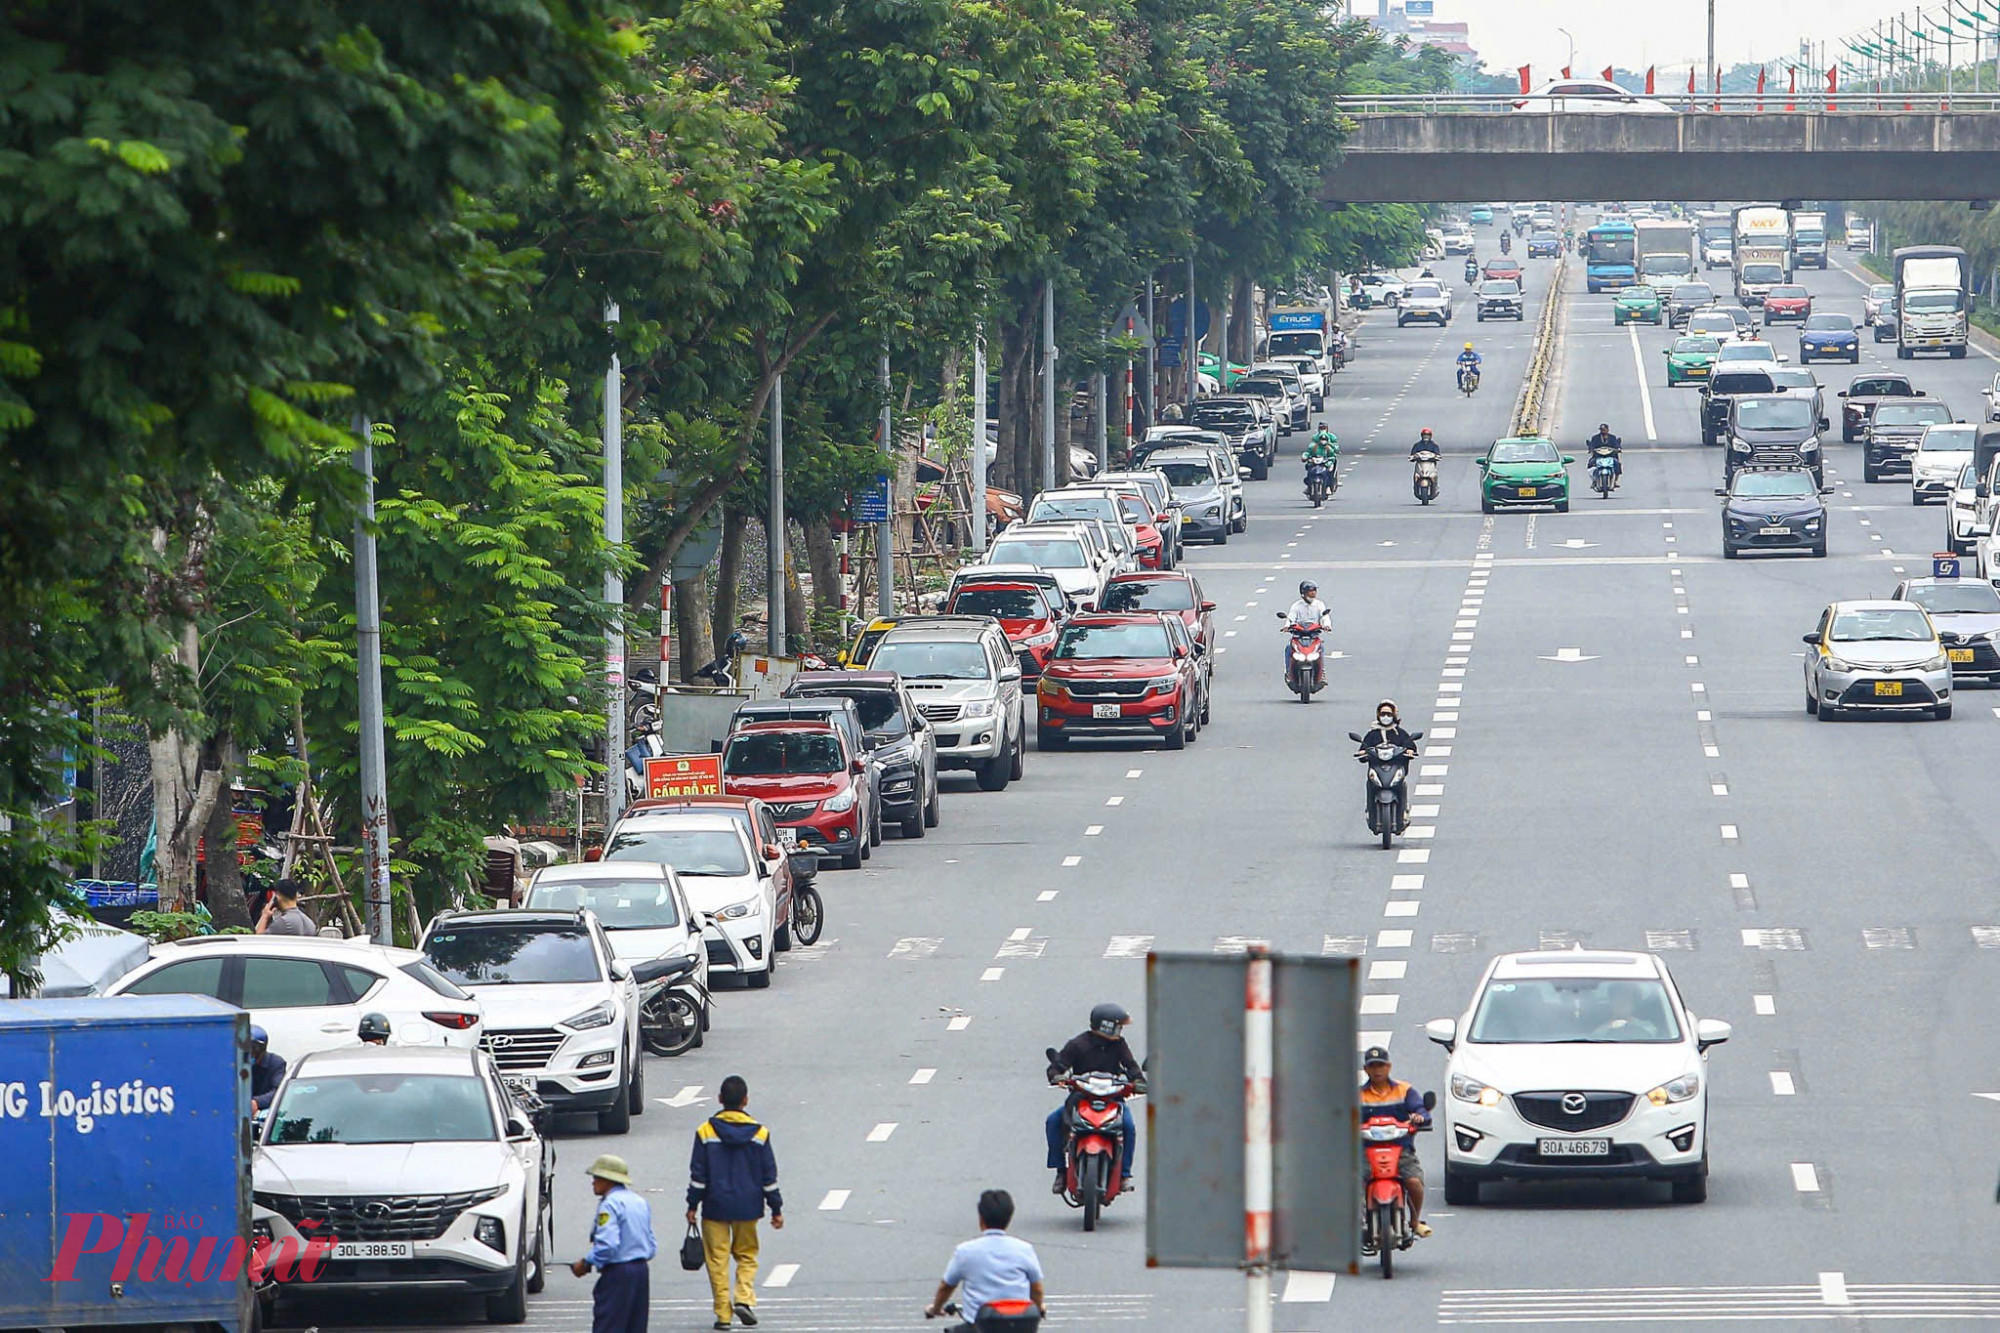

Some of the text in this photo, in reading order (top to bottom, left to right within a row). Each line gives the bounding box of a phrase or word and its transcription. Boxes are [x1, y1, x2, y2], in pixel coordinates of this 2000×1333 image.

[653, 782, 680, 798] CẤM
[683, 780, 699, 796] ĐỖ
[38, 1079, 175, 1134] Logistics
[338, 1244, 406, 1256] 30L-388.50
